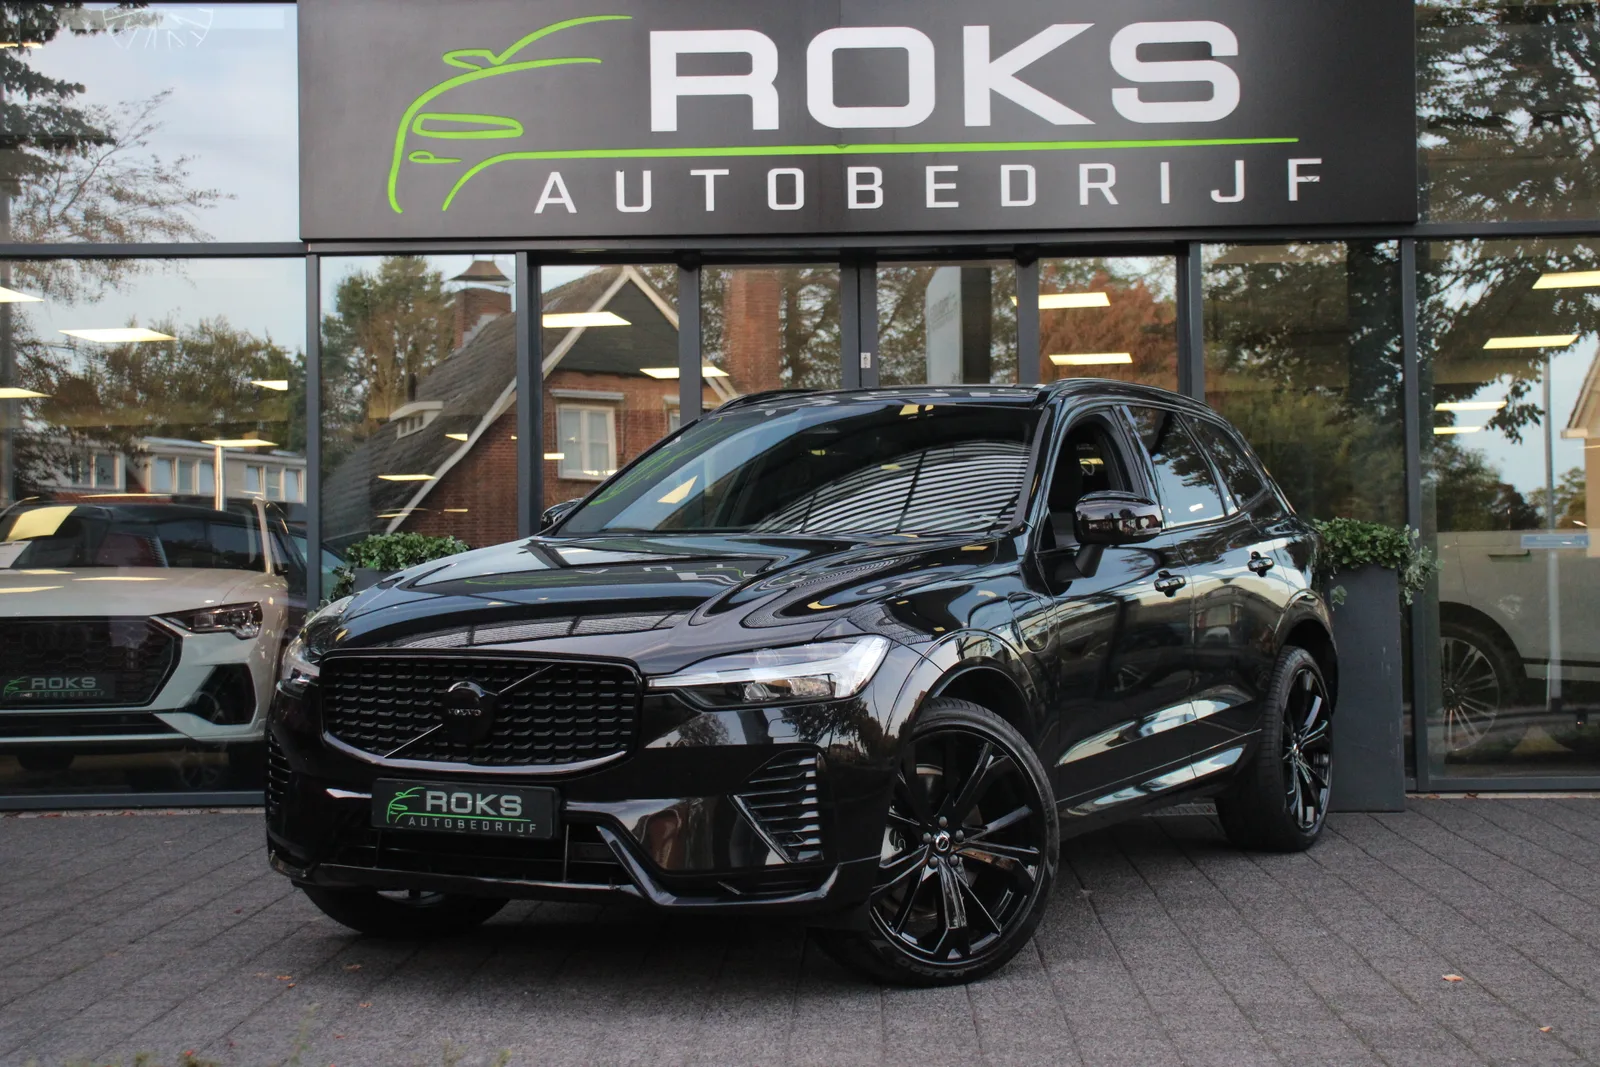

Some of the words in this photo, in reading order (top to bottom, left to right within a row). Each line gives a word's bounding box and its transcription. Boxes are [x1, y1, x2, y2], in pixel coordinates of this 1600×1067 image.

[650, 20, 1241, 131] ROKS
[534, 159, 1322, 214] AUTOBEDRIJF
[31, 677, 96, 689] ROKS
[426, 790, 522, 816] ROKS
[408, 816, 536, 834] AUTOBEDRIJF
